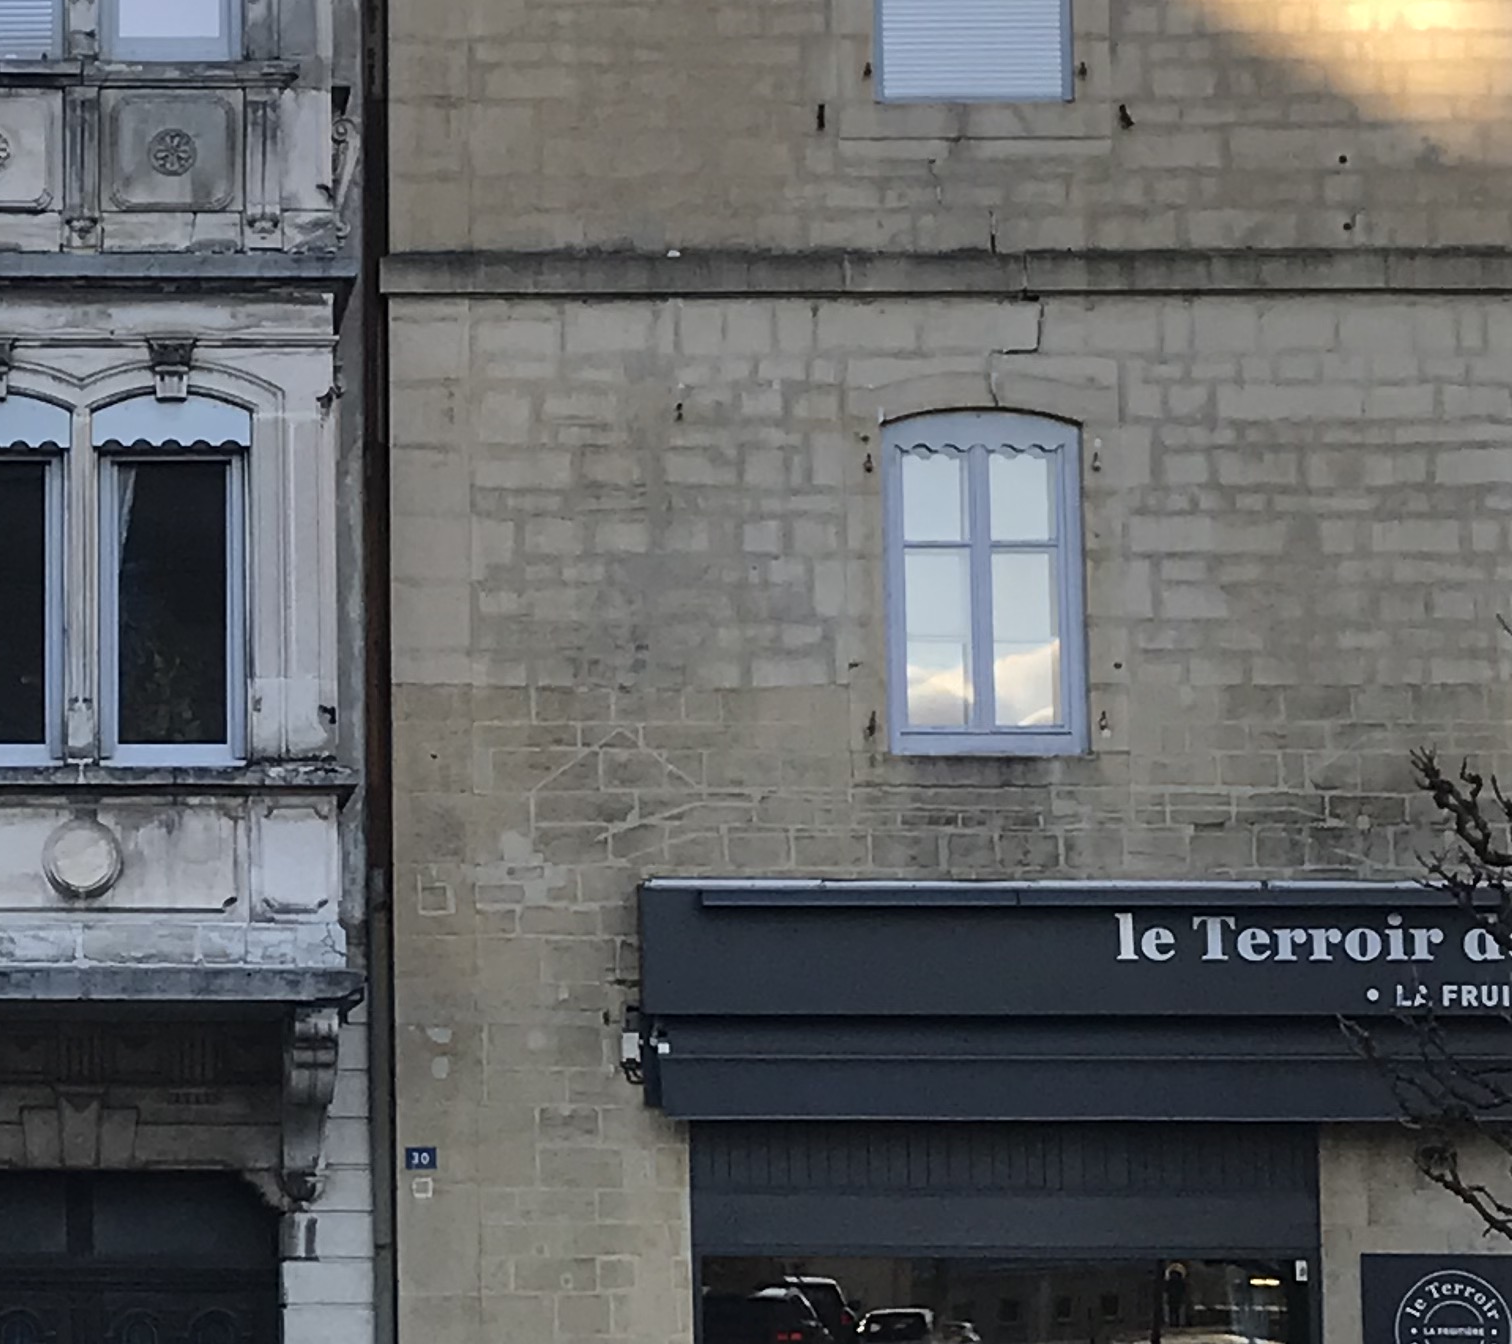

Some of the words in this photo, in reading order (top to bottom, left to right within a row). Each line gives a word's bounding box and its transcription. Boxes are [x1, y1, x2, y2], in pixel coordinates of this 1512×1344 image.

[1115, 912, 1176, 961] le
[1192, 913, 1444, 961] Terroir
[1463, 912, 1512, 961] d
[411, 1152, 430, 1165] 30
[1405, 1299, 1427, 1317] le
[1425, 1282, 1499, 1319] Terroir
